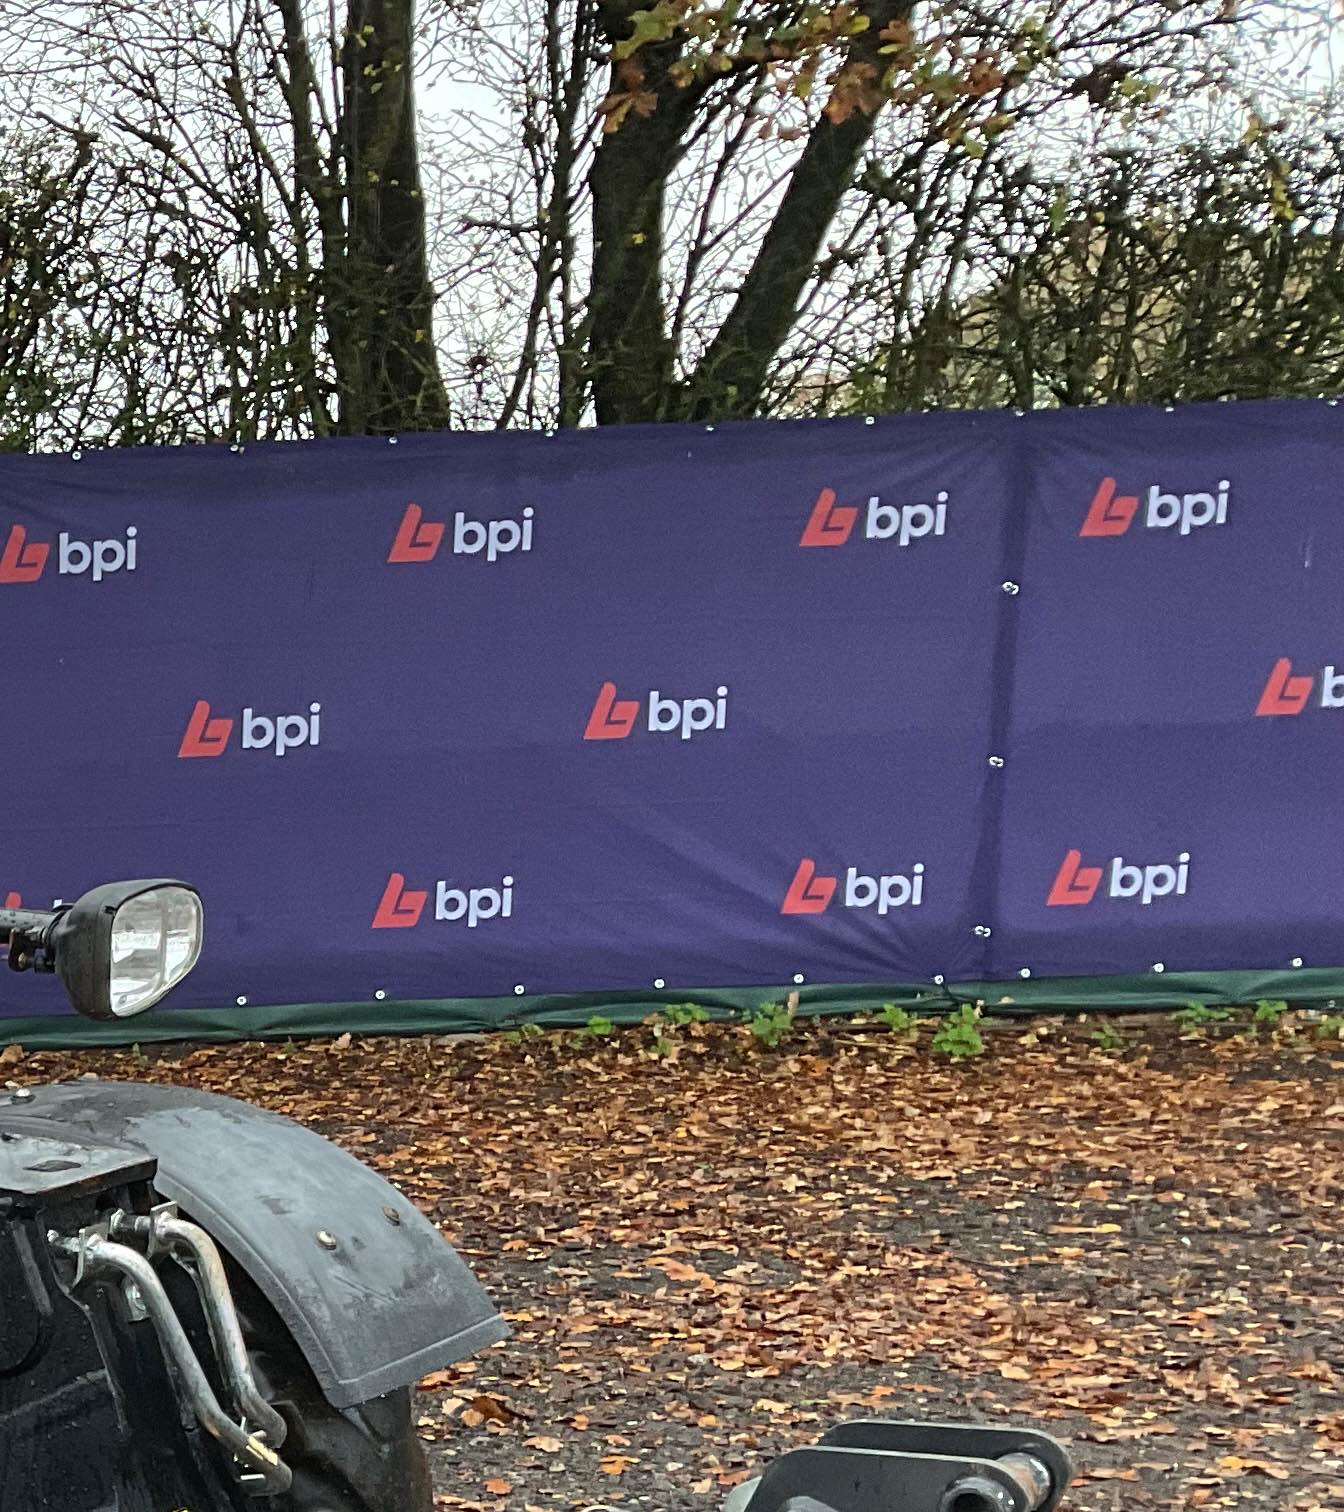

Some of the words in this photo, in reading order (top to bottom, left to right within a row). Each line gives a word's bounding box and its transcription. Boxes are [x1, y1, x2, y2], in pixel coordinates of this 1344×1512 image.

[453, 507, 534, 562] bpi
[865, 491, 948, 546] bpi
[1146, 479, 1230, 536] bpi
[59, 526, 138, 582] bpi
[242, 702, 321, 756] bpi
[648, 685, 728, 740] bpi
[435, 875, 514, 928] bpi
[844, 863, 925, 915] bpi
[1109, 852, 1190, 905] bpi
